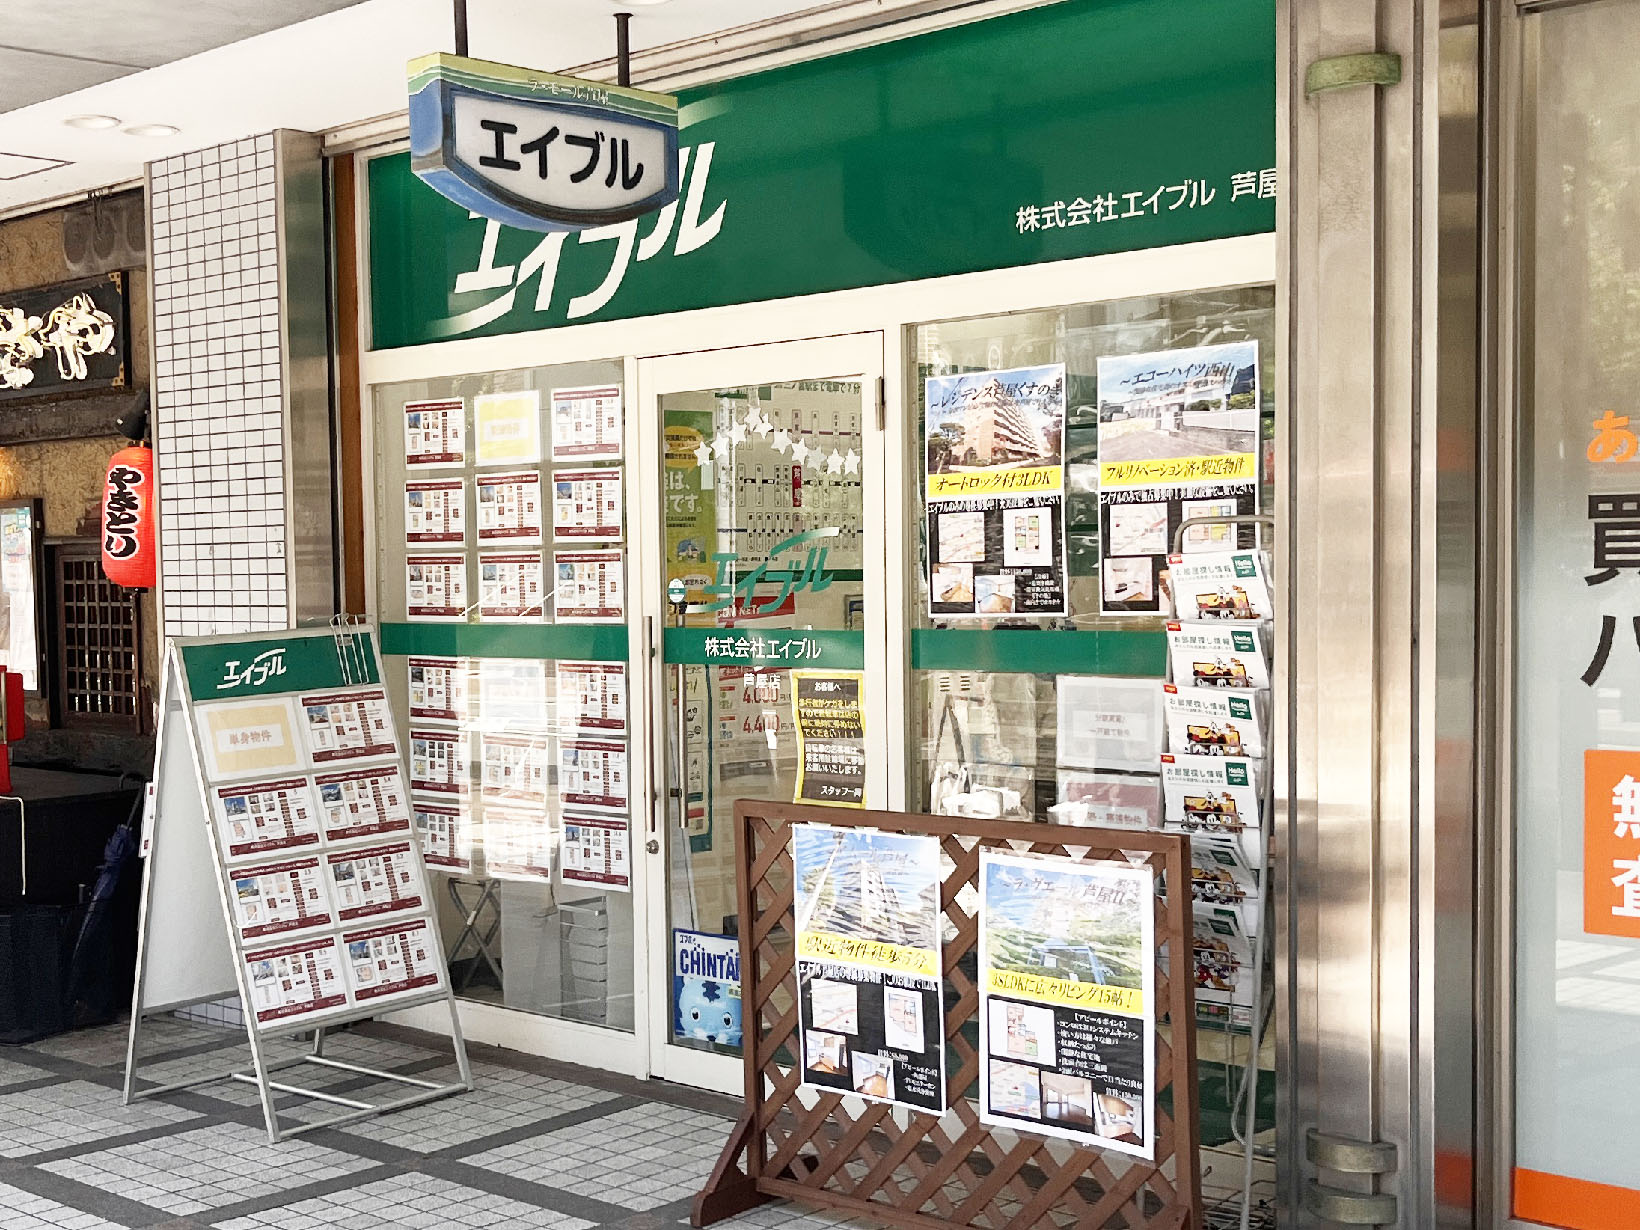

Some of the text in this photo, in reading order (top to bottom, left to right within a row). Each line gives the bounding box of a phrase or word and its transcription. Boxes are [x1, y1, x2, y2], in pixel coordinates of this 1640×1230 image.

[479, 119, 644, 190] エイブル
[1015, 168, 1277, 234] 株式会社エイブル 芦屋
[1587, 410, 1639, 464] あ
[936, 471, 1053, 491] オートロック付3LDK
[686, 527, 839, 613] エイブル
[216, 647, 287, 690] エイブル
[704, 636, 822, 659] 株式会社エイブル
[743, 673, 781, 690] 芦屋店
[680, 943, 741, 982] CHINTAI
